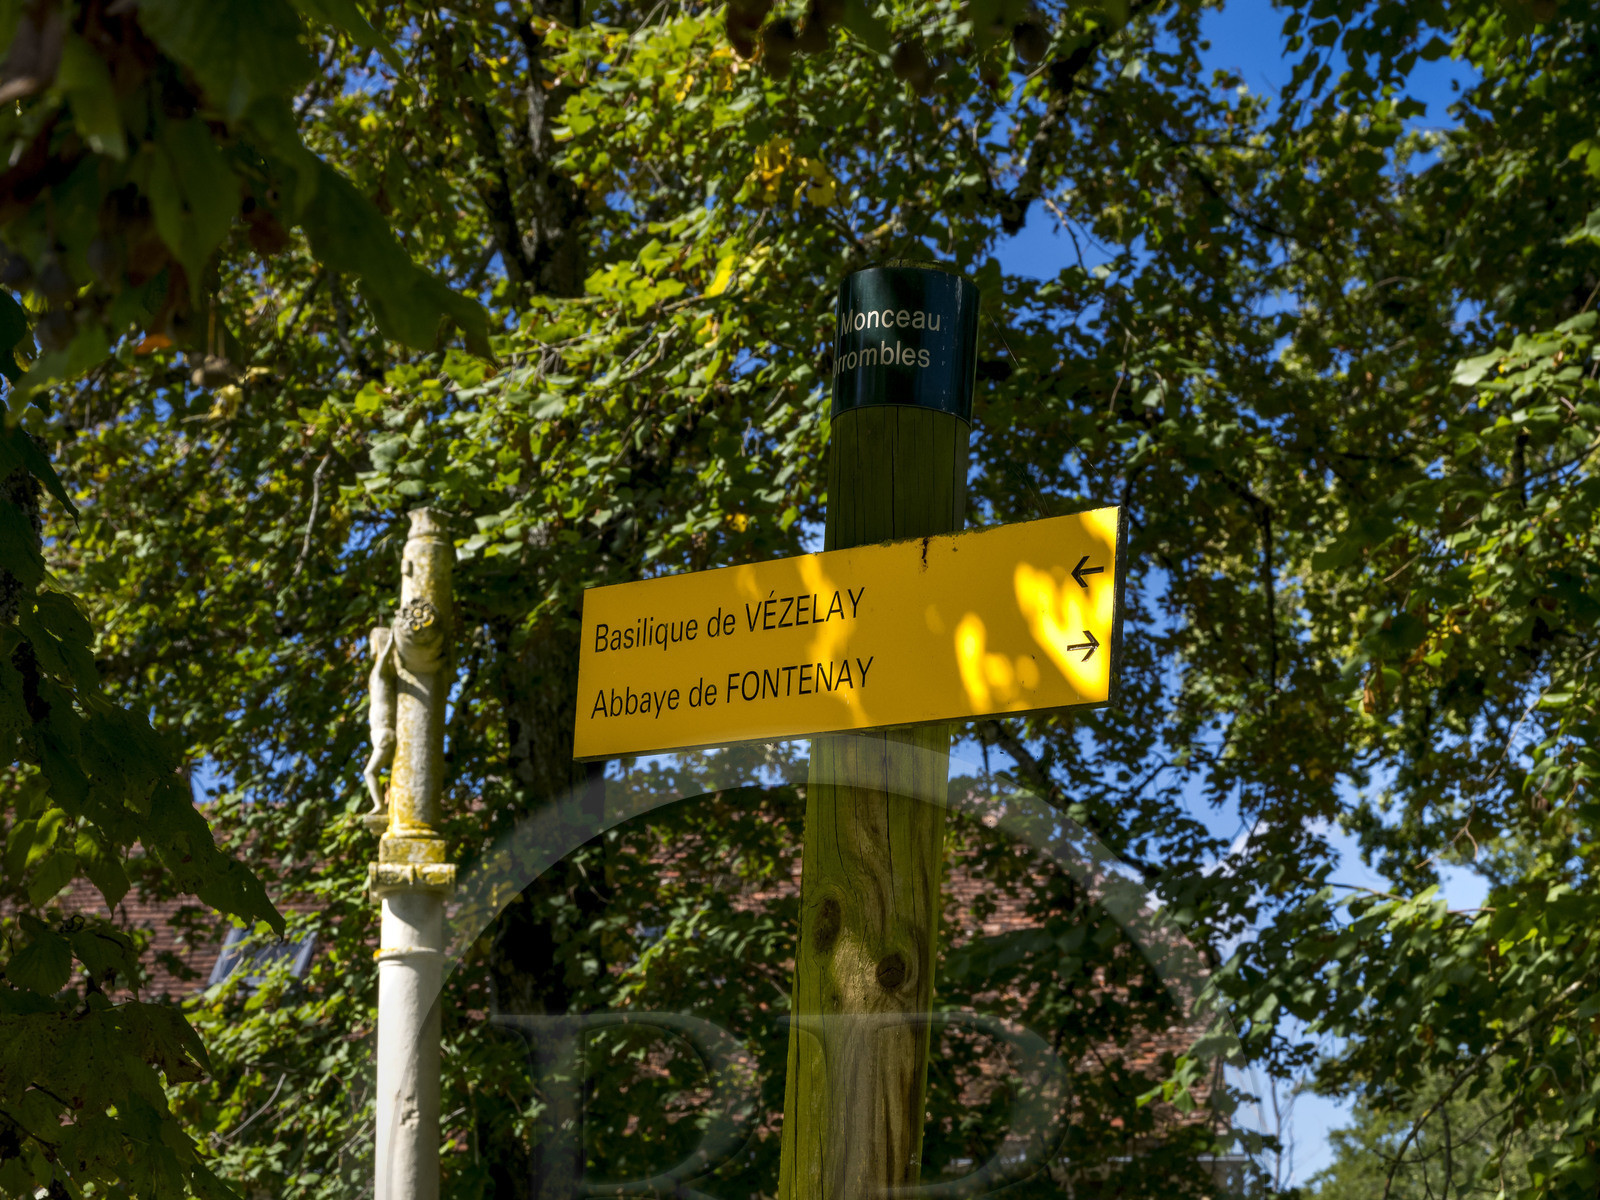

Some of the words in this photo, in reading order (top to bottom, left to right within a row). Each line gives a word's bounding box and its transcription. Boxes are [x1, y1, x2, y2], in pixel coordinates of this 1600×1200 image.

[841, 308, 941, 337] Monceau
[594, 617, 698, 653] Basilique
[707, 607, 736, 638] de
[745, 587, 865, 633] VÉZELAY
[590, 686, 680, 720] Abbaye
[688, 677, 718, 708] de
[726, 656, 874, 704] FONTENAY
